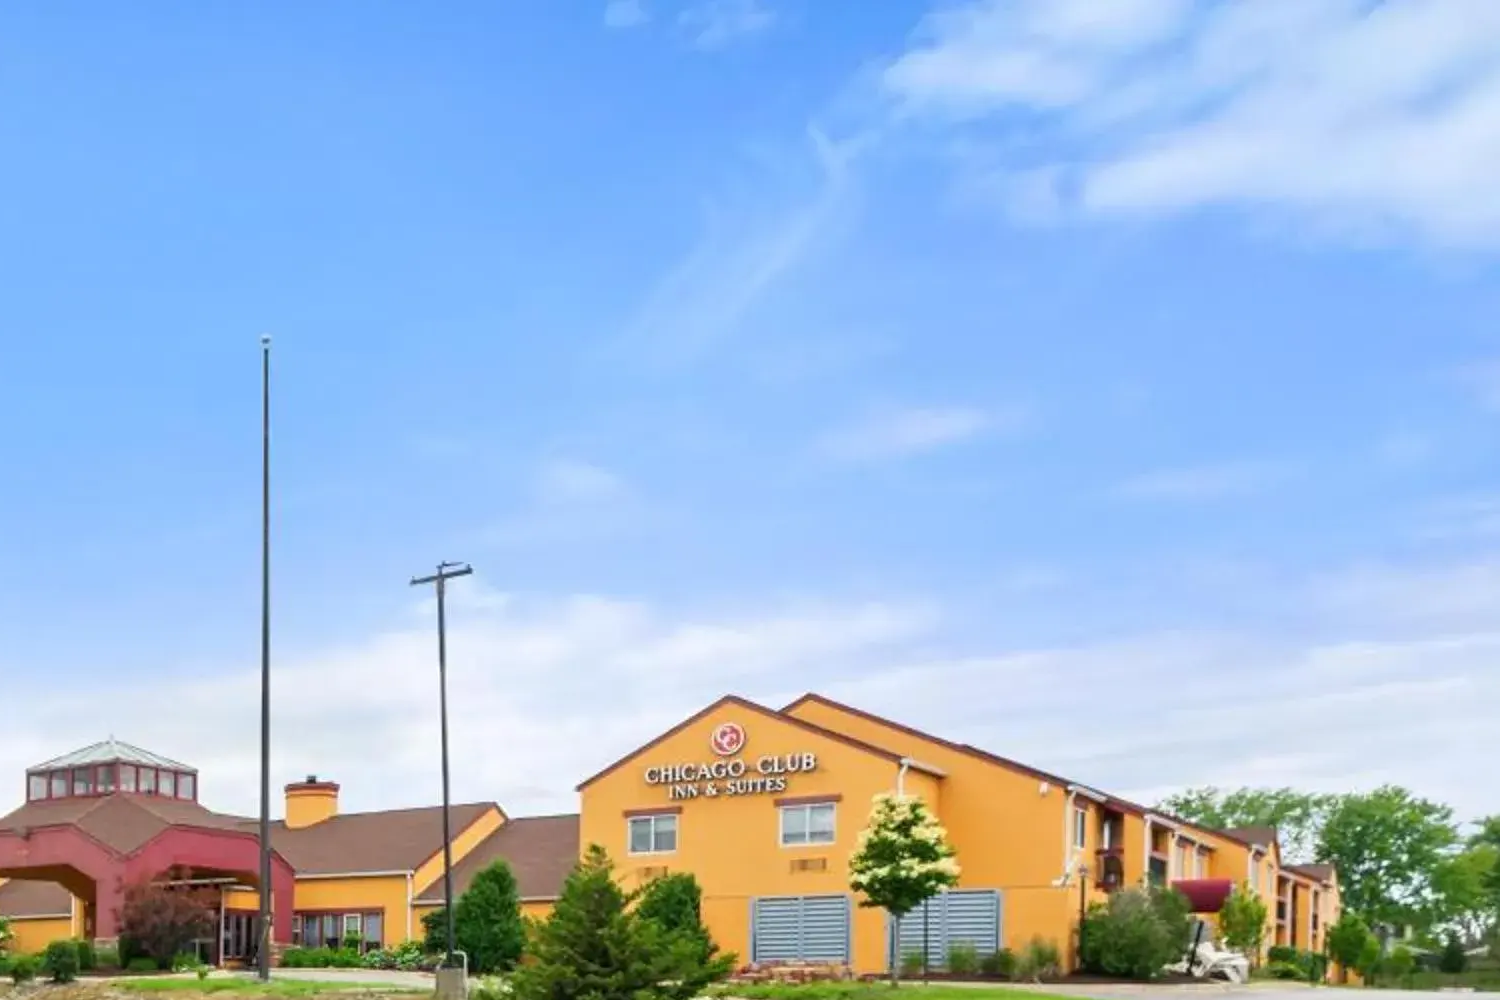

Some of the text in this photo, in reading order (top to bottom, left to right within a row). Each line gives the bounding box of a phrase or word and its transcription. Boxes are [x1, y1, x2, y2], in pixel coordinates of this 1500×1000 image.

[645, 752, 817, 784] CHICAGO CLUB
[668, 776, 787, 799] INN & SUITES
